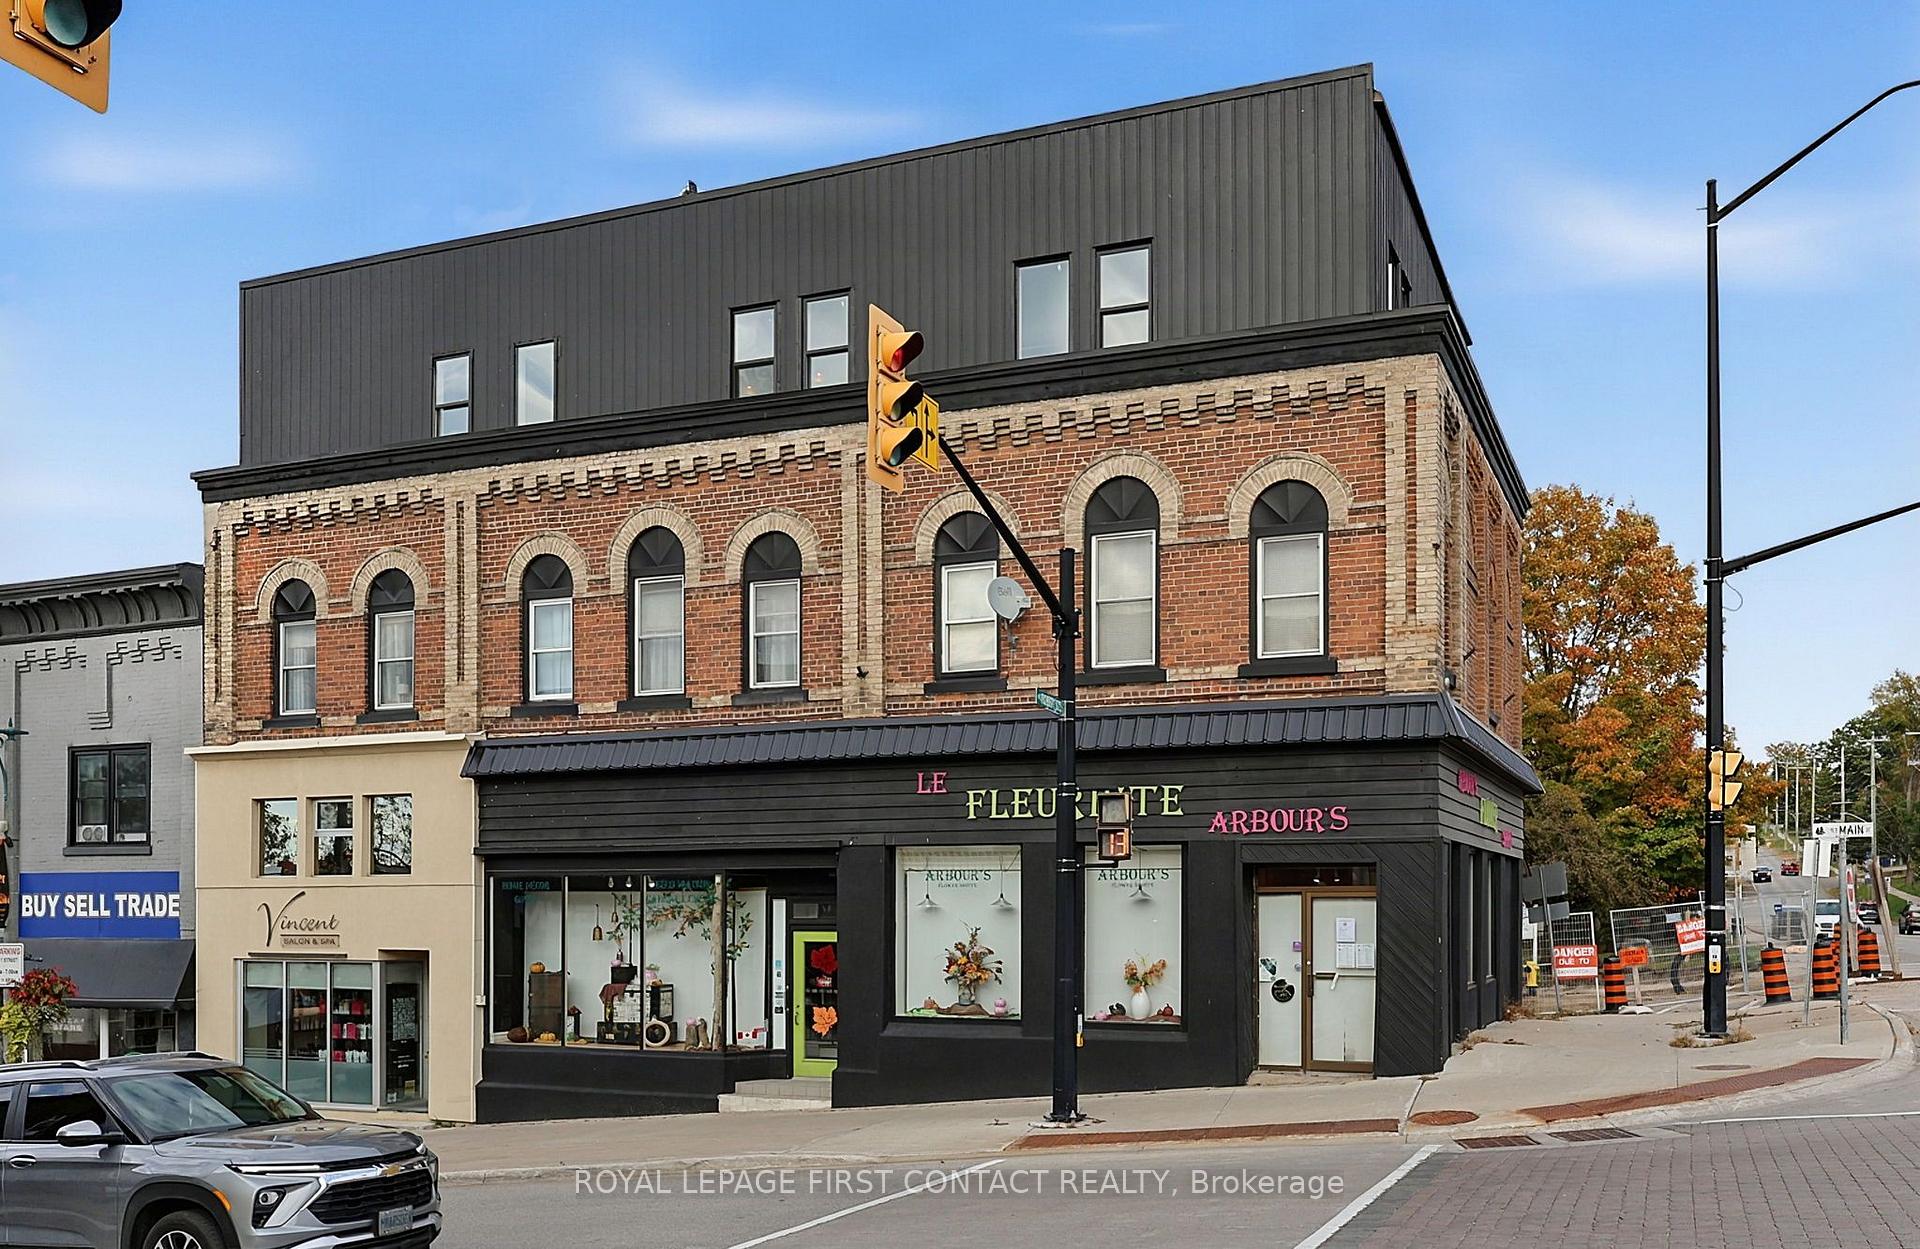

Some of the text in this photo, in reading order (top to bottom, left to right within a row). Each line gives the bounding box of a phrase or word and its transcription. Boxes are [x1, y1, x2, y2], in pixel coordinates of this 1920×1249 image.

[916, 771, 948, 794] LE
[1207, 805, 1350, 835] ARBOUR'S
[1839, 824, 1864, 835] MAIN
[925, 869, 992, 881] ARBOUR'S
[1097, 868, 1170, 881] ARBOUR'S
[21, 893, 60, 917] BUY
[64, 893, 111, 917] SELL
[114, 893, 180, 918] TRADE
[256, 890, 339, 948] Vincent
[283, 937, 336, 946] SALON & SPA
[1553, 946, 1595, 958] DANGER
[1558, 957, 1590, 966] DUE TO
